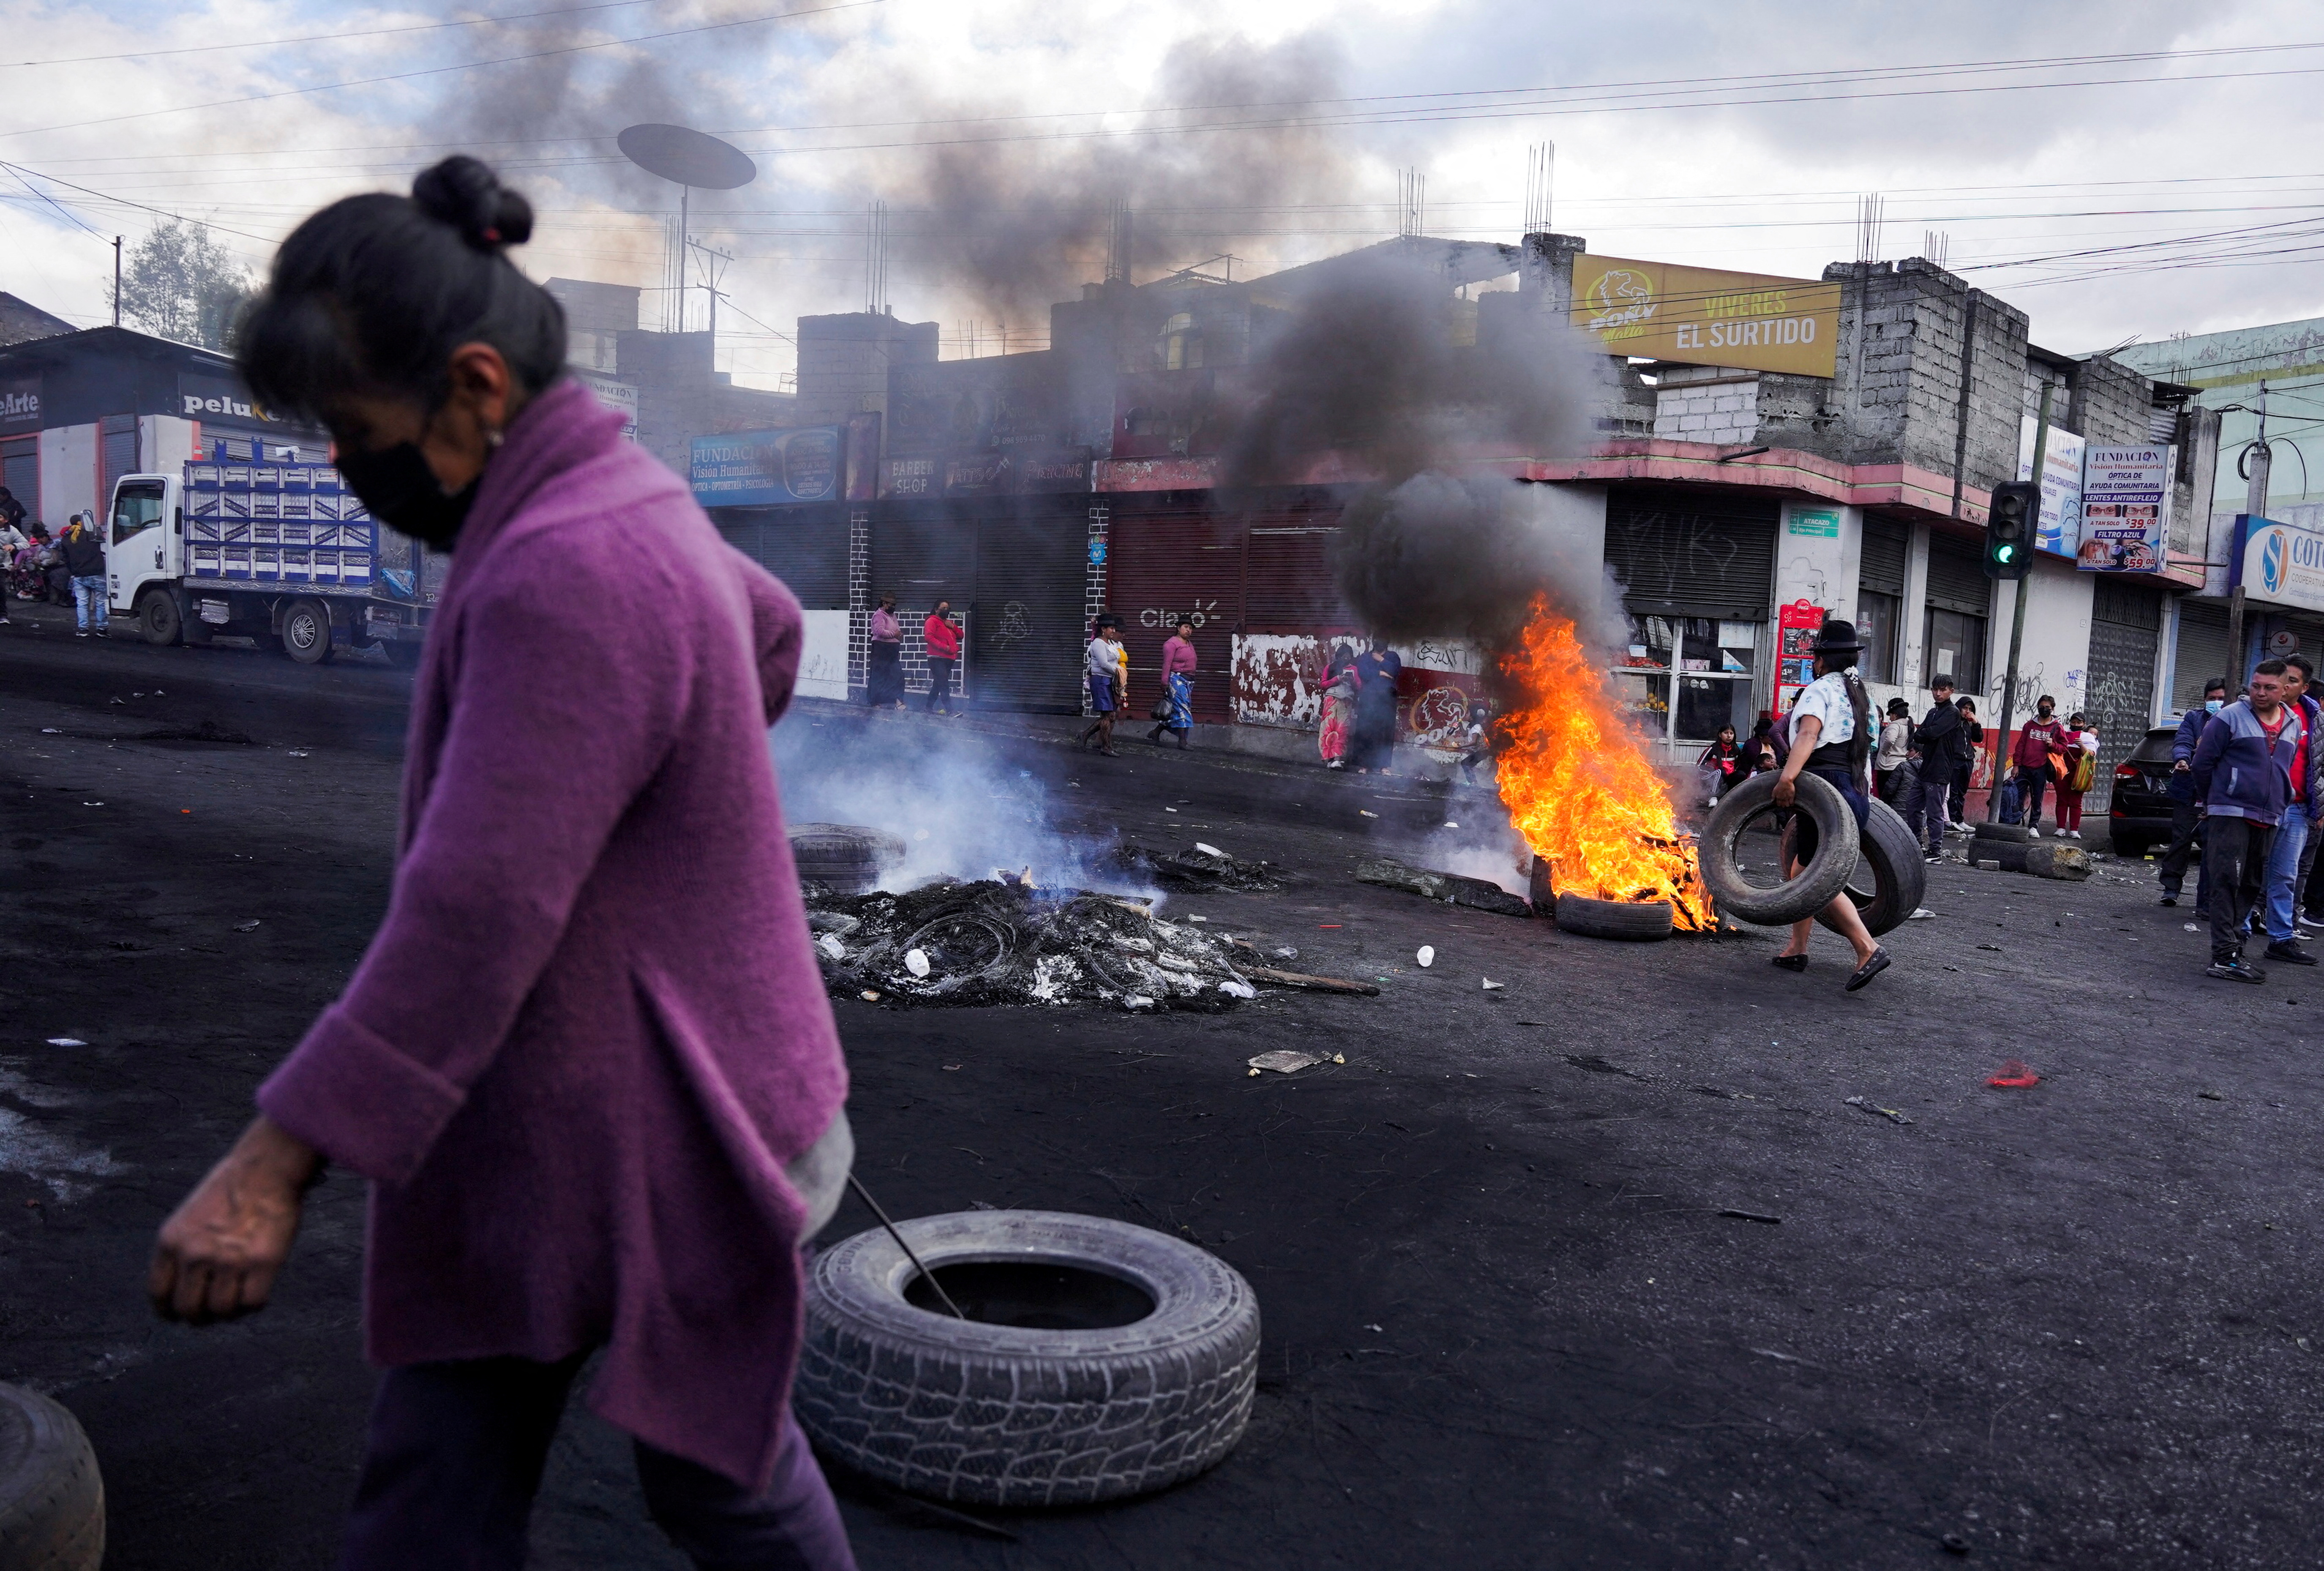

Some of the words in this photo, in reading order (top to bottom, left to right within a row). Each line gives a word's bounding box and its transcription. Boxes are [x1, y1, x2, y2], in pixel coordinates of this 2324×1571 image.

[1705, 292, 1787, 318] VÍVERES
[1590, 303, 1658, 333] PONY
[1601, 323, 1645, 344] Malta
[1677, 324, 1704, 349] EL
[1709, 318, 1815, 347] SURTIDO
[1002, 436, 1014, 445] 098
[692, 464, 717, 478] Visión
[892, 461, 934, 476] BARBER
[2046, 452, 2079, 473] Humanitaria
[691, 480, 708, 492] ÓPTICA
[712, 477, 742, 491] OPTOMETRÍA
[896, 478, 927, 494] SHOP
[2042, 472, 2055, 485] AYUDA
[2056, 476, 2080, 492] COMUNITARIA
[1803, 518, 1830, 526] ATACAZO
[2037, 521, 2047, 530] ENTES
[2293, 535, 2324, 569] COT
[1140, 608, 1206, 628] Clao
